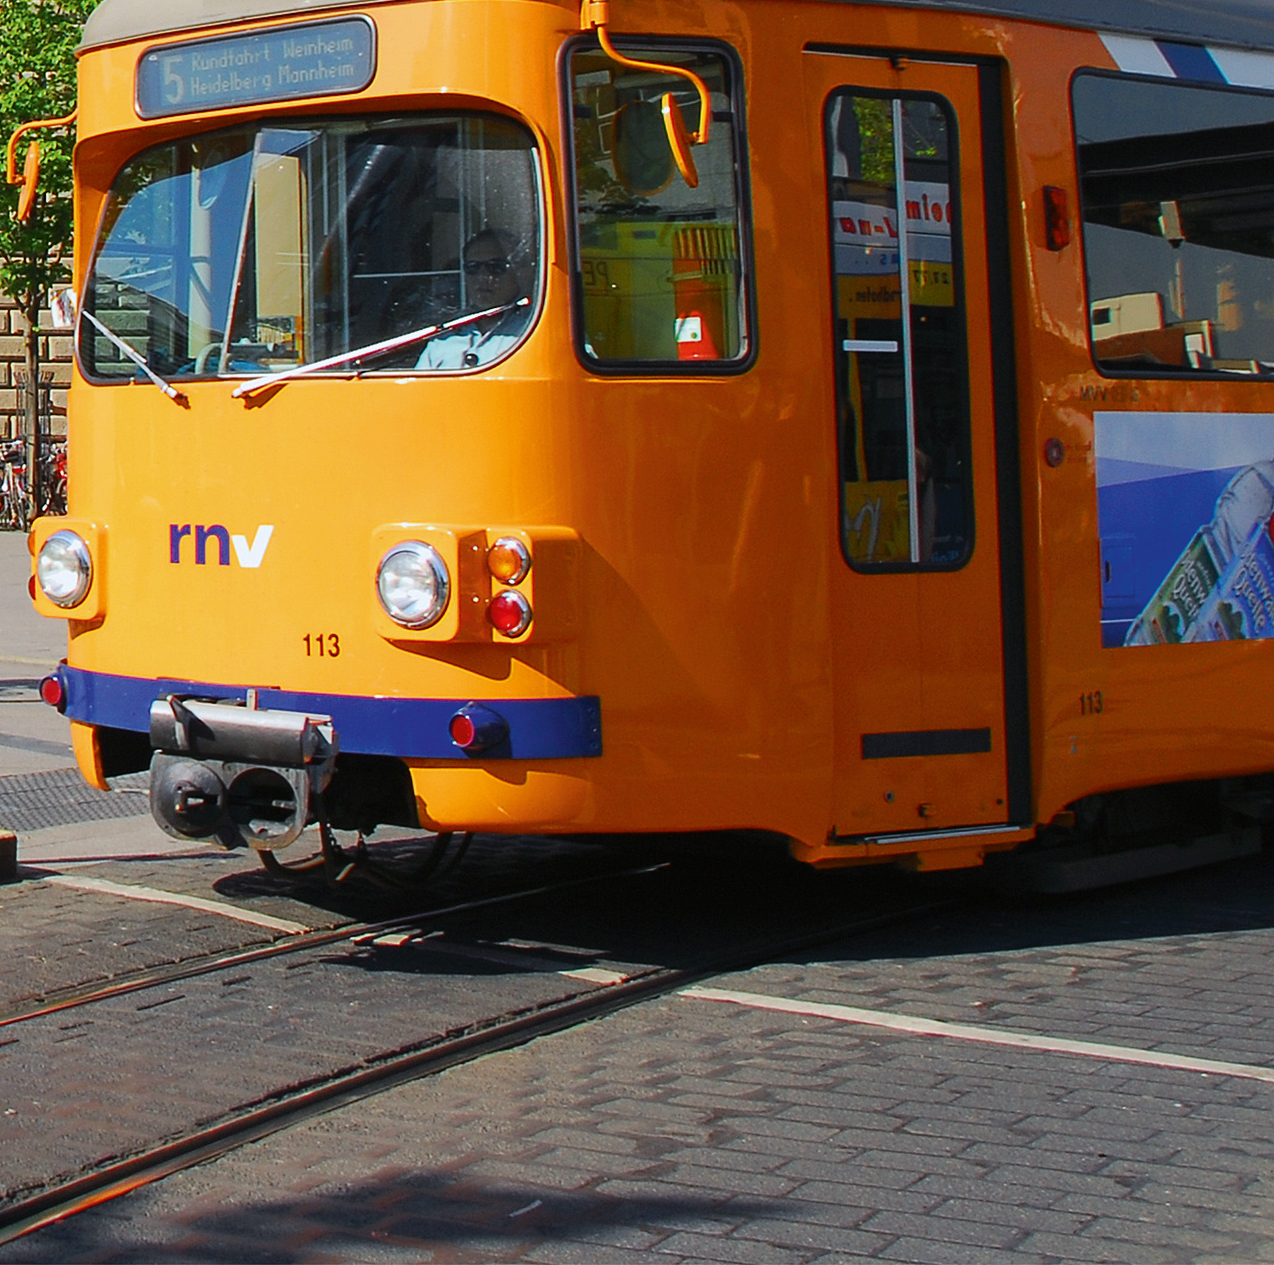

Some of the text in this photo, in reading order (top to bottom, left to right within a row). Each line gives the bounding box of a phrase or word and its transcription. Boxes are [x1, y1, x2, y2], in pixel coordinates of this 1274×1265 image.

[283, 38, 353, 59] Weinheim
[164, 55, 184, 104] 5
[191, 61, 353, 96] Heidelberg Mannheim
[170, 524, 274, 568] rnv
[303, 633, 341, 657] 113
[1079, 690, 1104, 715] 113
